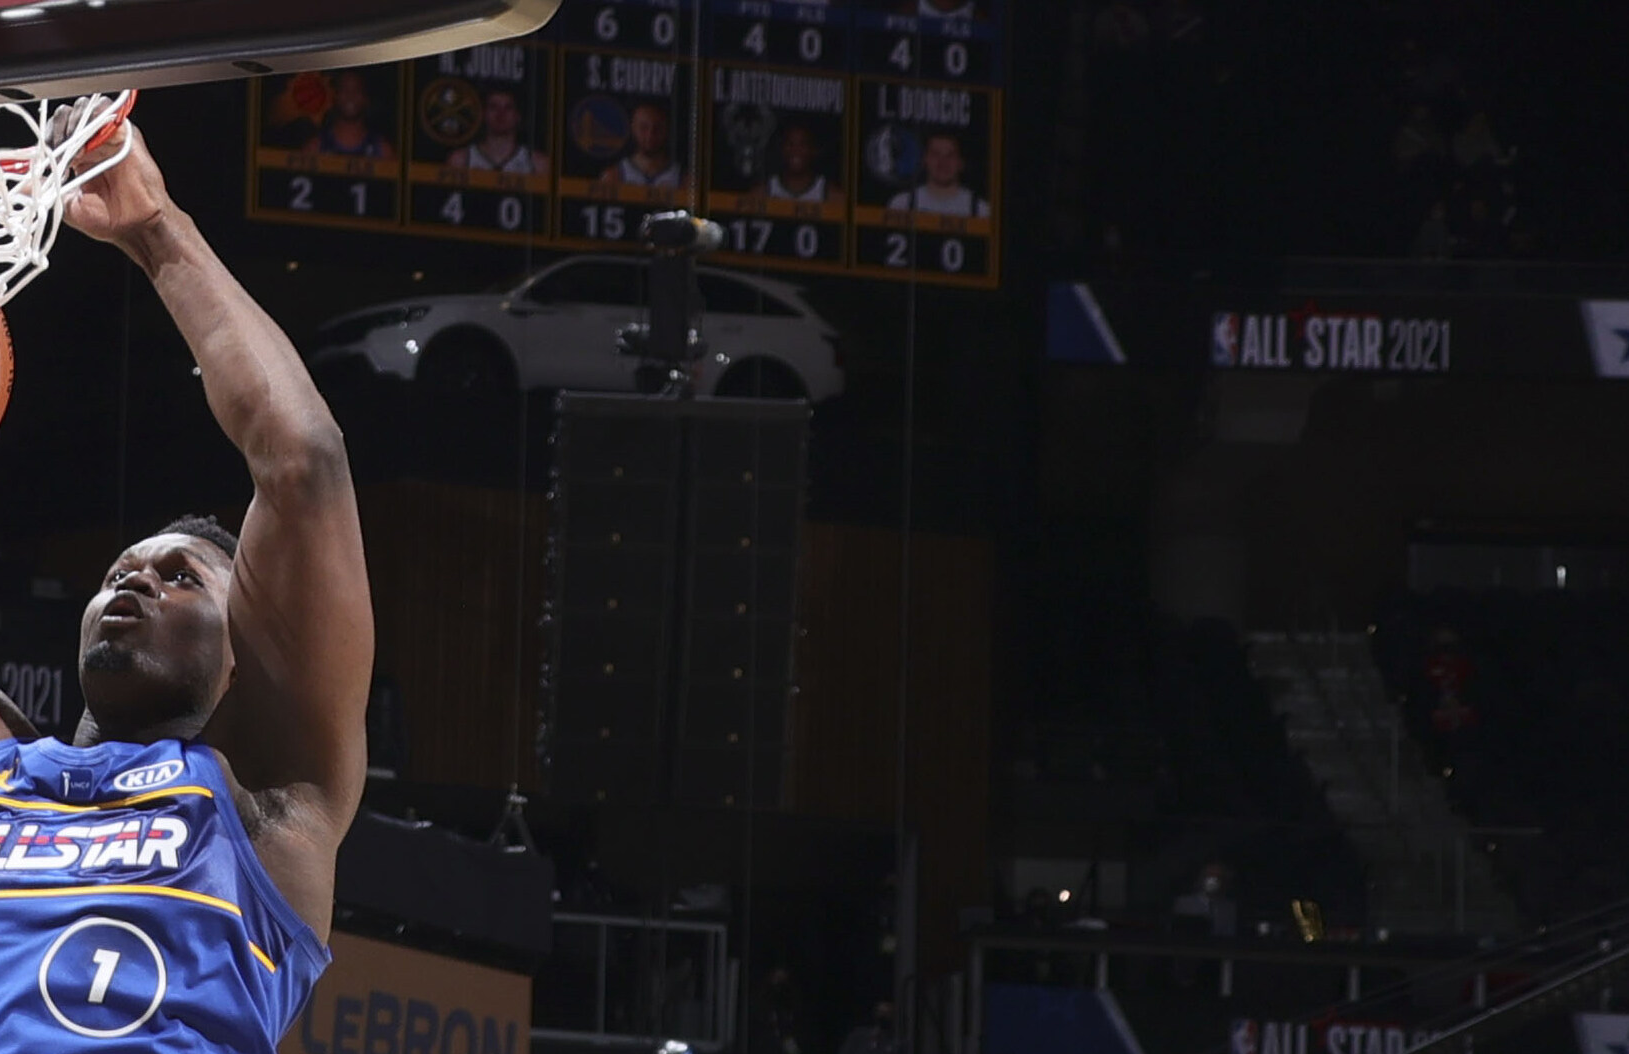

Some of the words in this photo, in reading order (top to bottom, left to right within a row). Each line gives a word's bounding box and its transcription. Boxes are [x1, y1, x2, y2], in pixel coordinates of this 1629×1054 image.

[594, 7, 619, 41] 6
[652, 12, 675, 45] 0
[742, 22, 767, 56] 4
[799, 28, 822, 62] 0
[889, 37, 912, 71] 4
[944, 43, 968, 76] 0
[289, 175, 313, 210] 2
[350, 182, 368, 215] 1
[442, 191, 465, 224] 4
[498, 197, 521, 230] 0
[581, 206, 626, 240] 15
[728, 220, 773, 254] 17
[795, 225, 818, 259] 0
[885, 233, 908, 266] 2
[942, 239, 964, 272] 0
[1241, 314, 1291, 367] ALL
[1304, 317, 1383, 371] STAR
[1388, 319, 1451, 373] 2021
[87, 948, 120, 1004] 1
